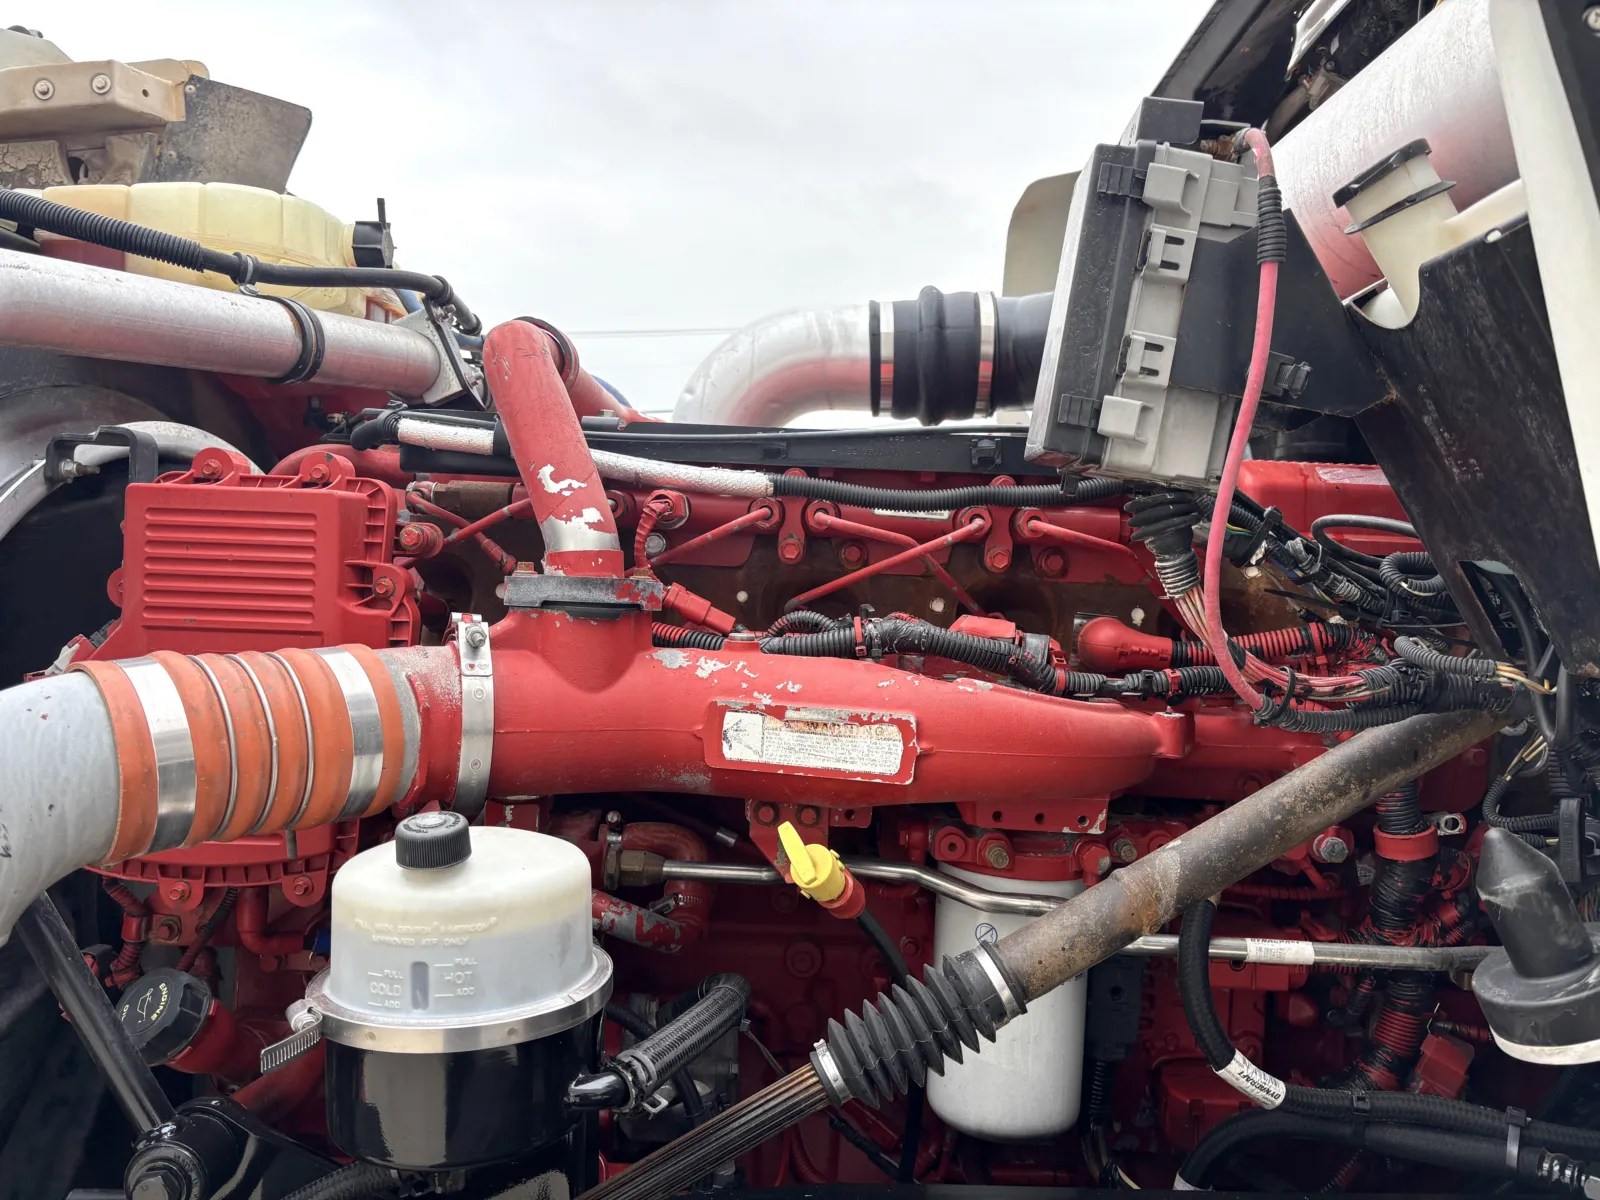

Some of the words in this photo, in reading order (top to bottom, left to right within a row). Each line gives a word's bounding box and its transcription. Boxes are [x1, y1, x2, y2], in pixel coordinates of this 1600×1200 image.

[807, 722, 884, 737] WARNNG
[444, 936, 469, 946] ONLY
[454, 957, 478, 966] FULL
[384, 969, 403, 979] FULL
[443, 971, 473, 984] HOT
[369, 981, 401, 997] COLD
[456, 987, 475, 997] ADD
[151, 982, 169, 1021] ENGINE
[384, 1000, 401, 1009] ADD
[121, 1004, 130, 1021] OIL
[1237, 1070, 1282, 1100] DYNACRAFT
